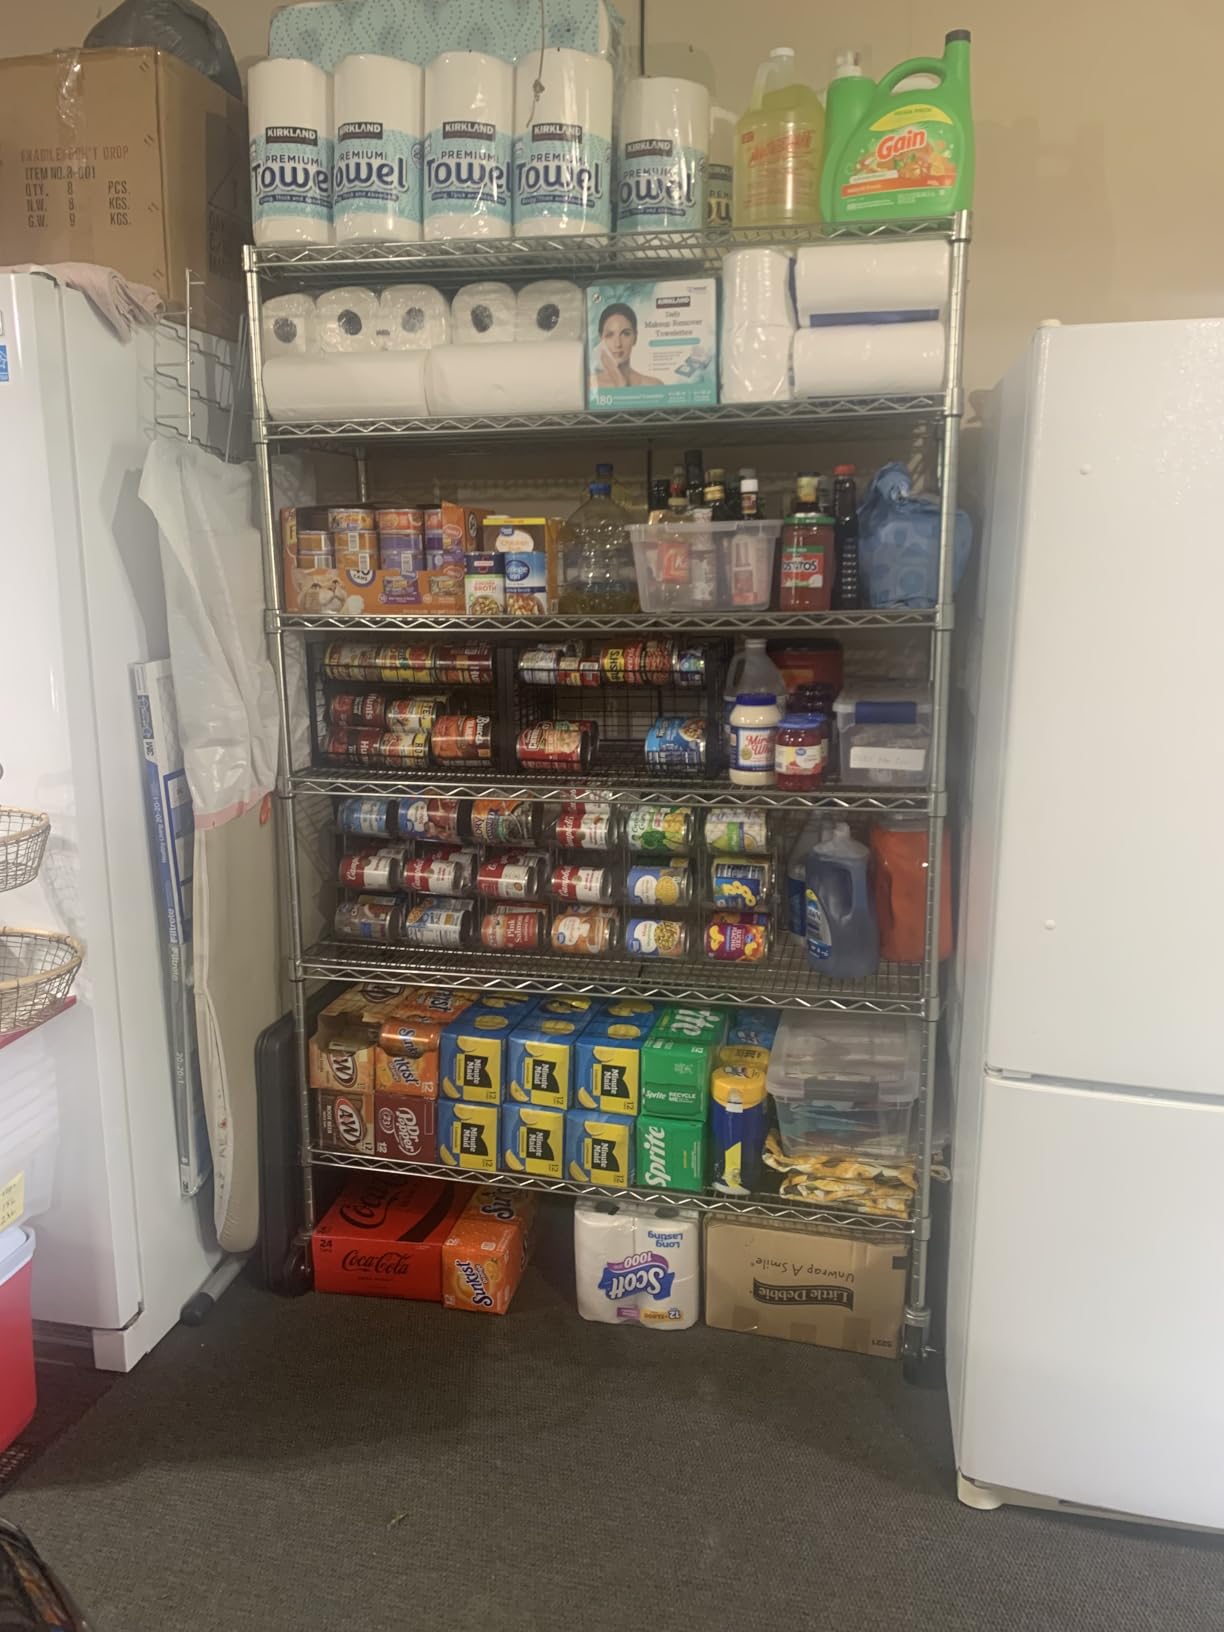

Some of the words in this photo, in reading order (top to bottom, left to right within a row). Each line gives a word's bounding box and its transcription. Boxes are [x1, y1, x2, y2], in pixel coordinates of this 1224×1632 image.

[267, 128, 317, 140] KIRKLAND
[445, 124, 494, 134] KIRKLAND
[626, 140, 671, 152] KIRKLAND
[877, 129, 926, 161] Gain
[266, 154, 319, 166] PREMIUM
[441, 150, 496, 162] PREMIUM
[252, 162, 329, 194] Towe
[516, 162, 600, 194] Towel
[507, 919, 516, 938] Pink
[541, 1063, 549, 1088] Minute
[610, 1068, 619, 1094] Minute
[490, 1091, 496, 1100] 12
[558, 1096, 564, 1105] 12
[645, 1089, 667, 1100] Sprite
[628, 1102, 634, 1110] 12
[396, 1110, 416, 1152] Pepper
[364, 1142, 372, 1151] 12
[644, 1126, 672, 1187] Sprite
[554, 1164, 559, 1172] 12
[618, 1175, 624, 1184] 12
[648, 1230, 684, 1240] Lasting
[320, 1239, 333, 1248] 24
[656, 1240, 681, 1248] Long
[624, 1251, 652, 1268] 1000
[755, 1256, 788, 1273] Smile
[792, 1264, 804, 1276] A
[807, 1263, 855, 1283] Unwrap
[455, 1258, 493, 1308] Sunkist
[609, 1267, 664, 1299] Scott
[758, 1286, 806, 1300] Debbie
[810, 1289, 849, 1302] Little
[668, 1309, 681, 1318] 12
